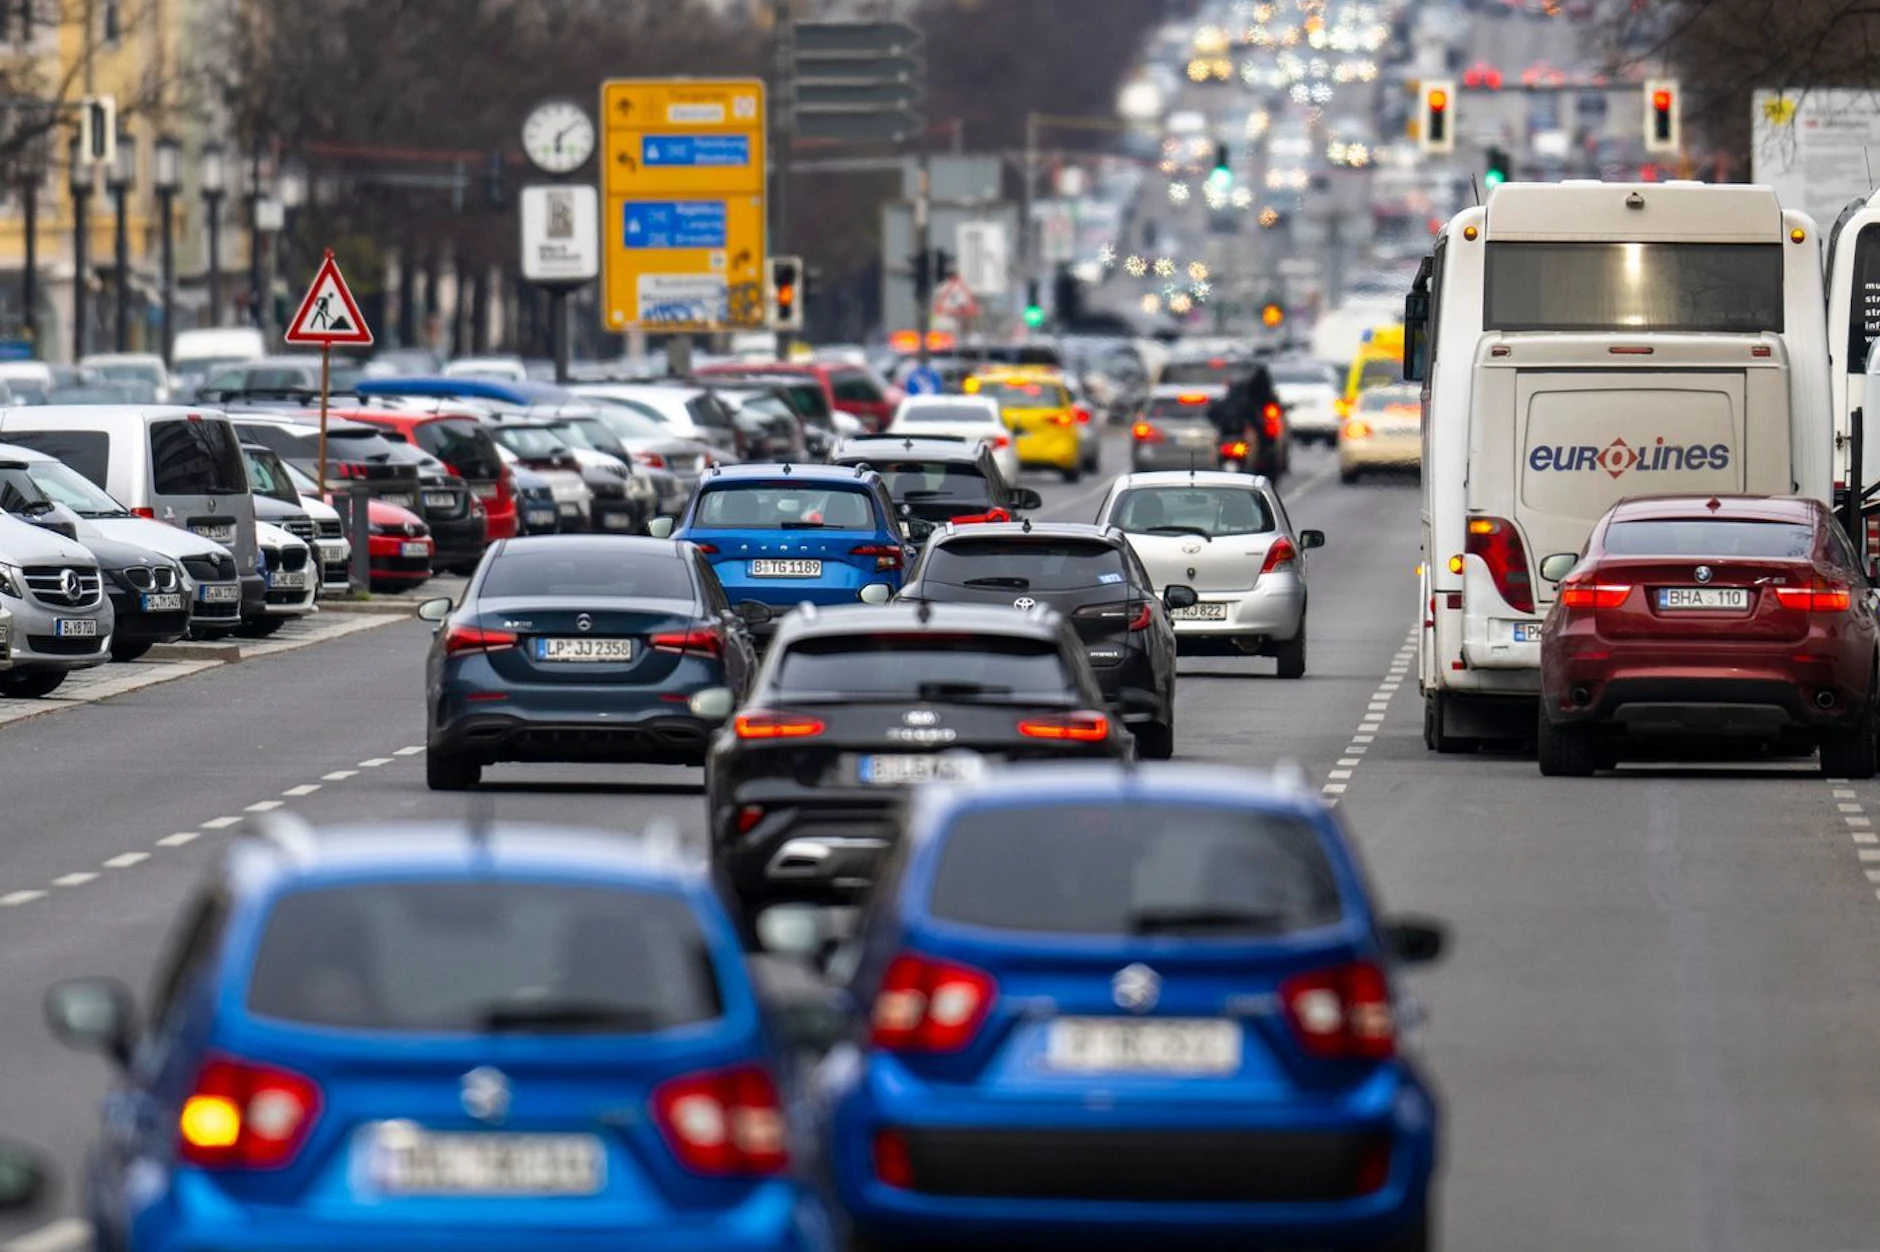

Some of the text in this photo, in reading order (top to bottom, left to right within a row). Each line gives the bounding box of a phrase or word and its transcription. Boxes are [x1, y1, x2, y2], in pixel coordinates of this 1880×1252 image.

[754, 561, 820, 574] B TG 1189
[1669, 590, 1741, 605] BHA 110
[1182, 604, 1198, 616] RJ
[1200, 604, 1221, 616] 822
[546, 641, 629, 656] LP JJ 2358
